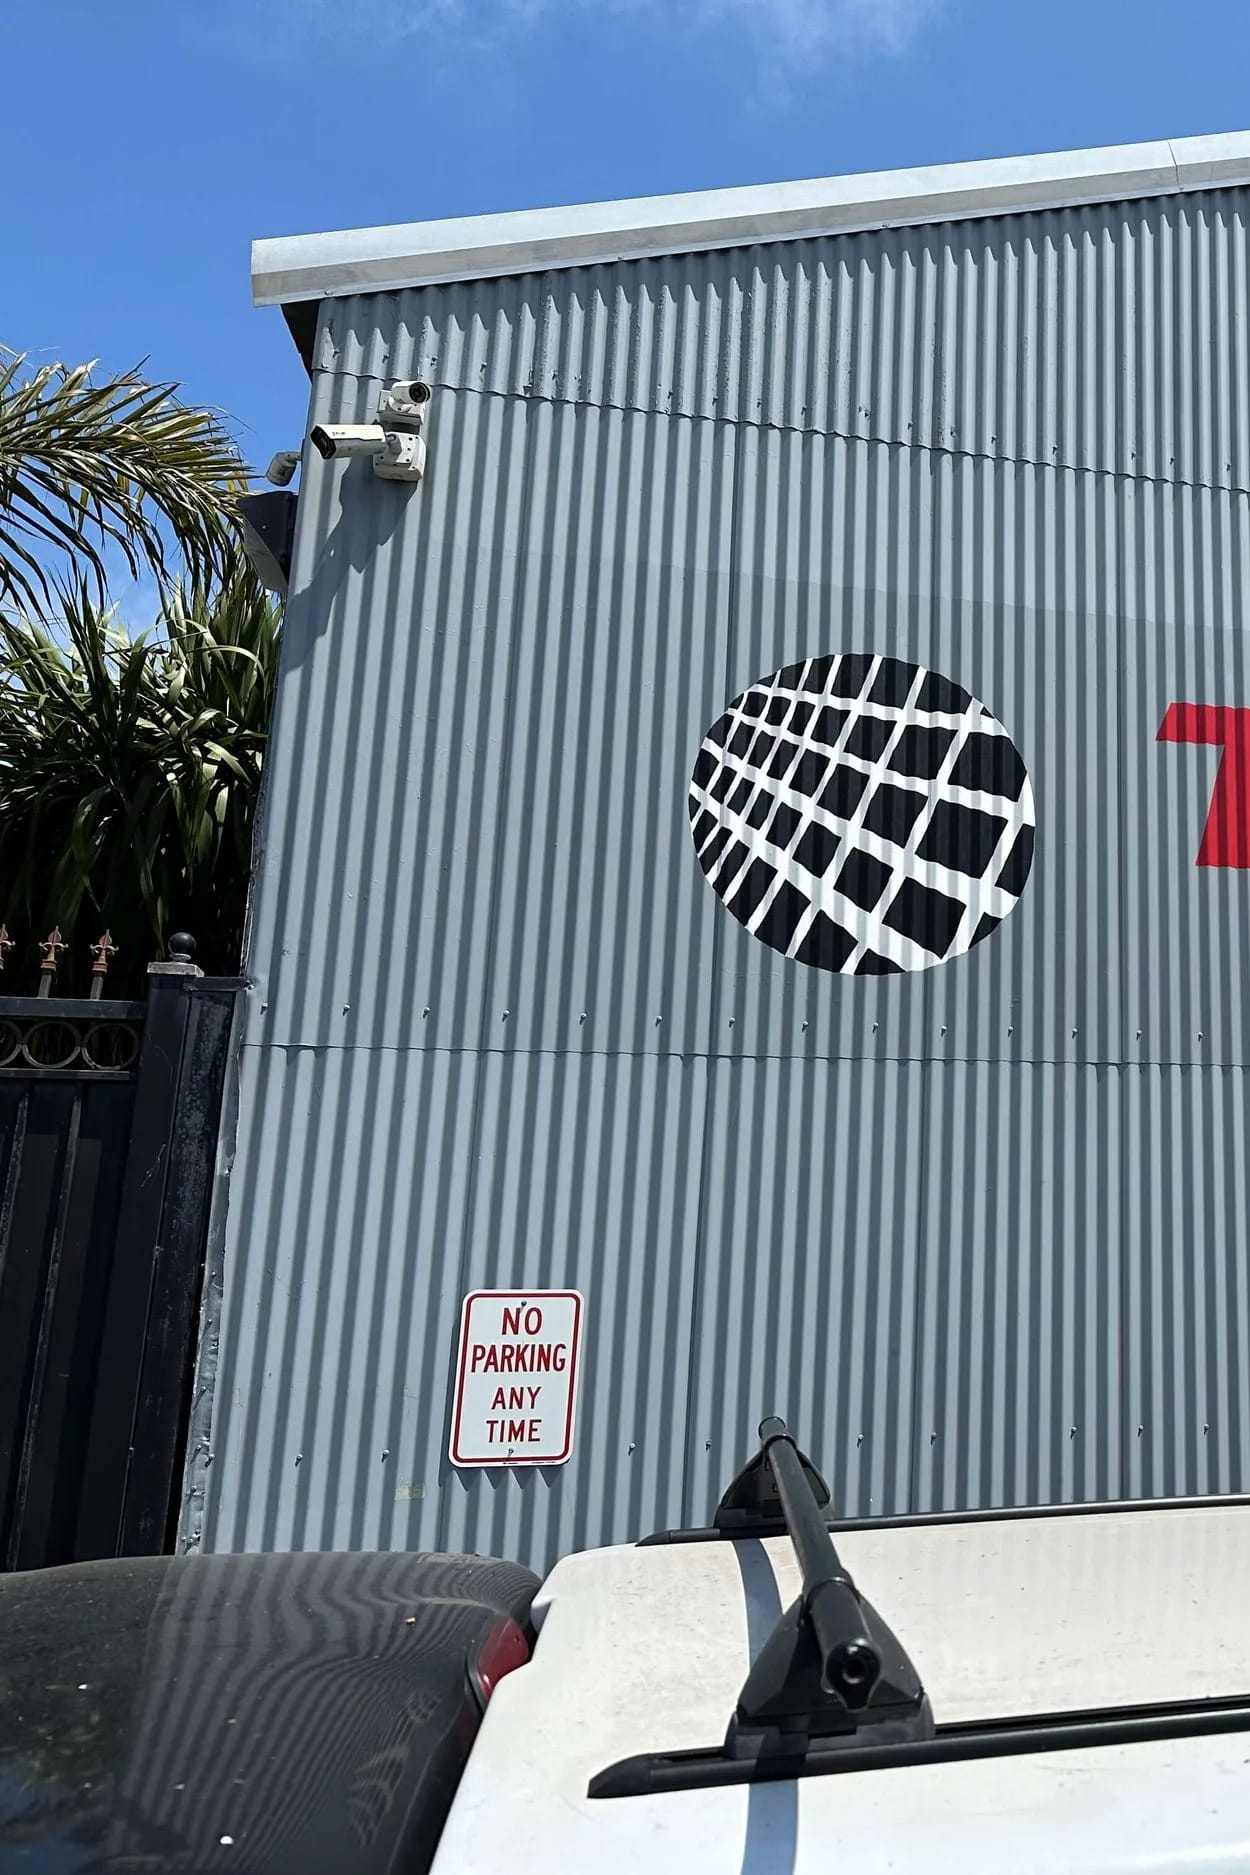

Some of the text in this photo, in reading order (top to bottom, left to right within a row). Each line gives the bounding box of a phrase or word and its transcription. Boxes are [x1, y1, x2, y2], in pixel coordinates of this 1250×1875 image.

[501, 1307, 542, 1335] NO
[471, 1343, 566, 1373] PARKING
[491, 1386, 542, 1410] ANY
[486, 1419, 543, 1443] TIME
